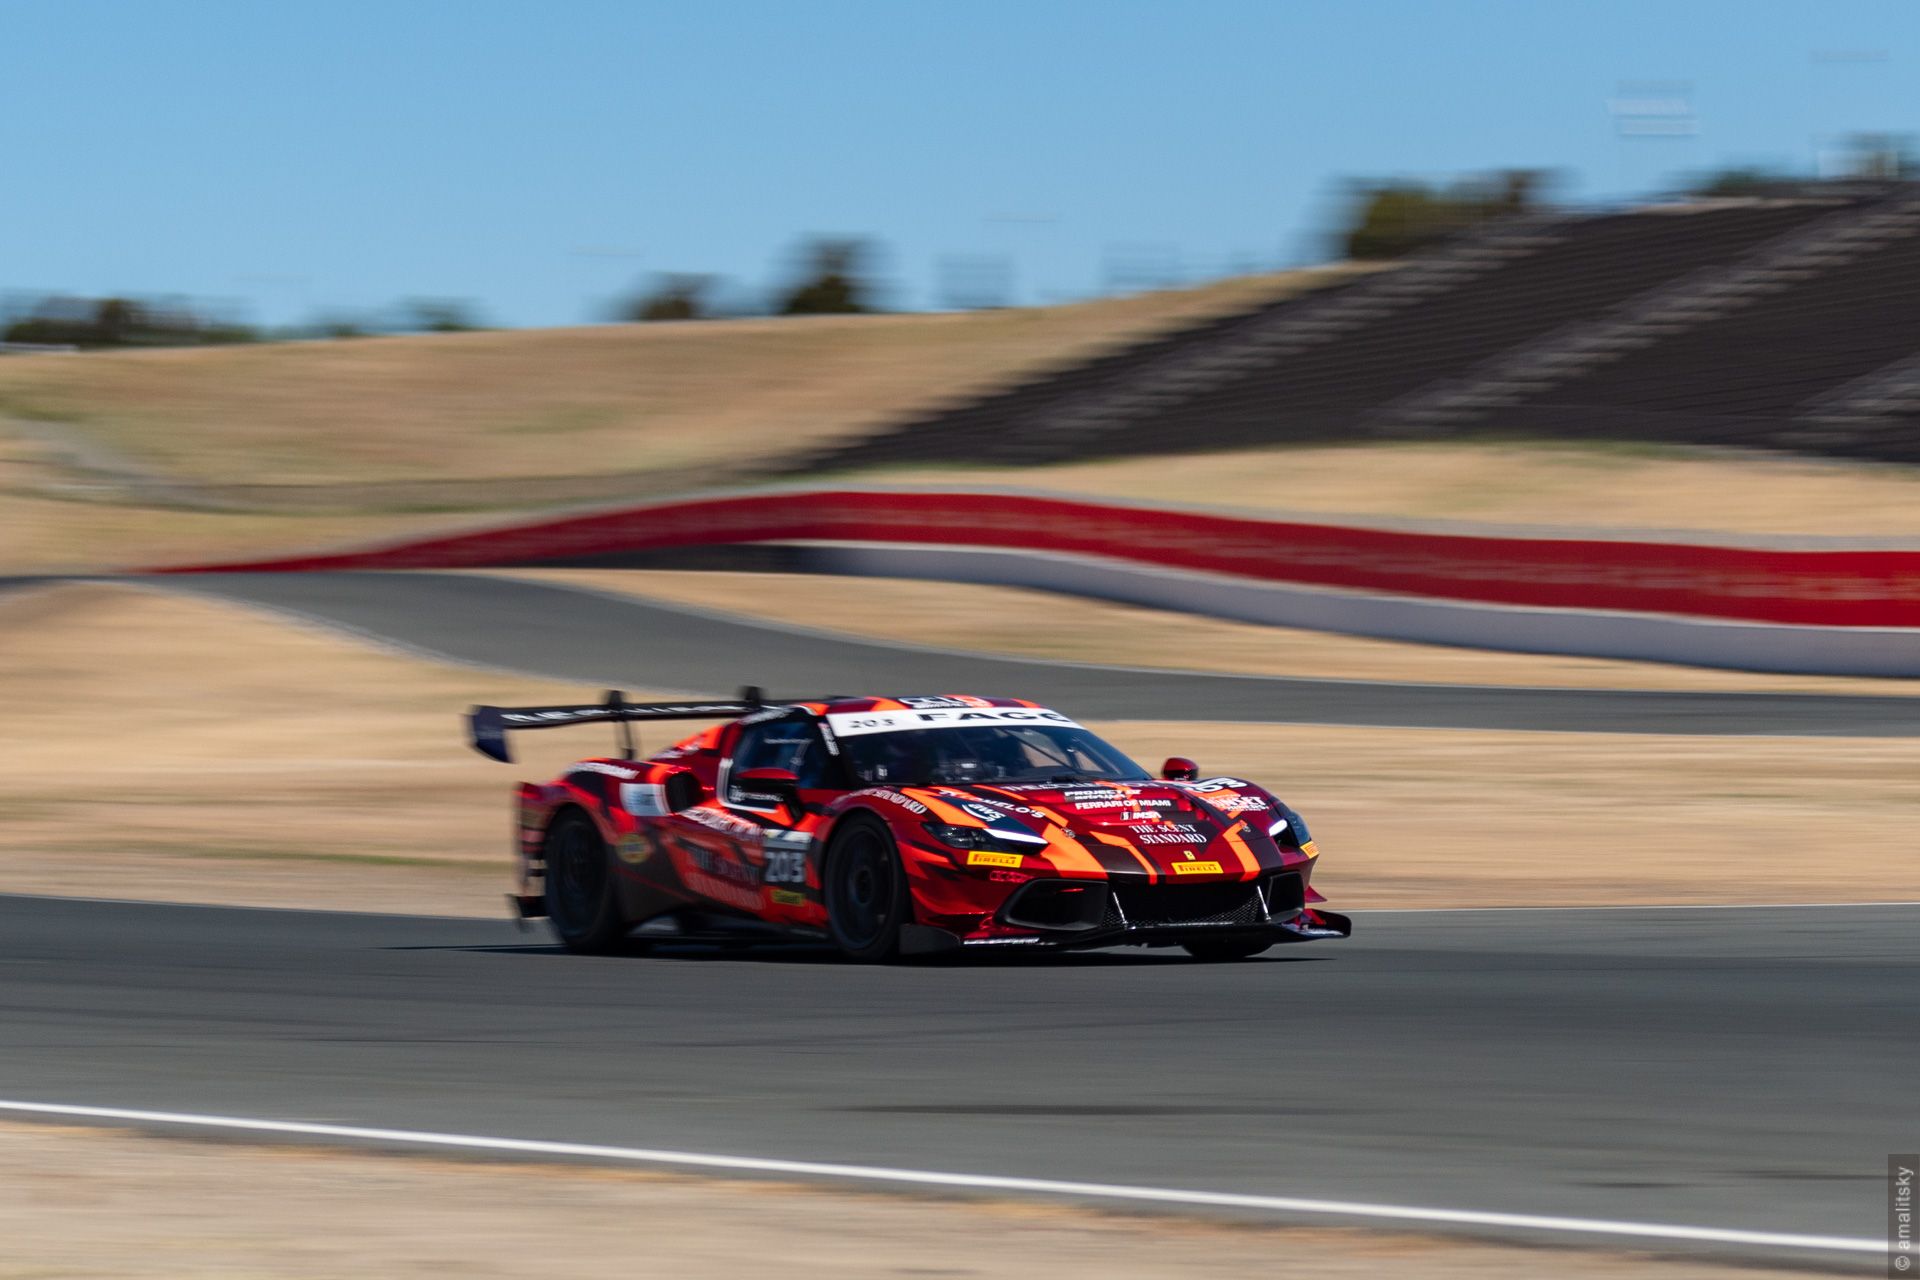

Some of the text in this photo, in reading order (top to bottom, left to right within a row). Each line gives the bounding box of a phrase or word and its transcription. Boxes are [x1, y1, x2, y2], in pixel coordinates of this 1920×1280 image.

[850, 719, 896, 728] 203
[1075, 801, 1123, 810] FERRARI
[967, 803, 1007, 819] aws
[1132, 811, 1162, 819] IMSA
[1129, 824, 1197, 833] THE SCENT
[1139, 833, 1208, 844] STANDARD
[973, 853, 1017, 865] PIRELLI
[764, 851, 806, 883] 203
[1178, 863, 1218, 872] PIRELLI
